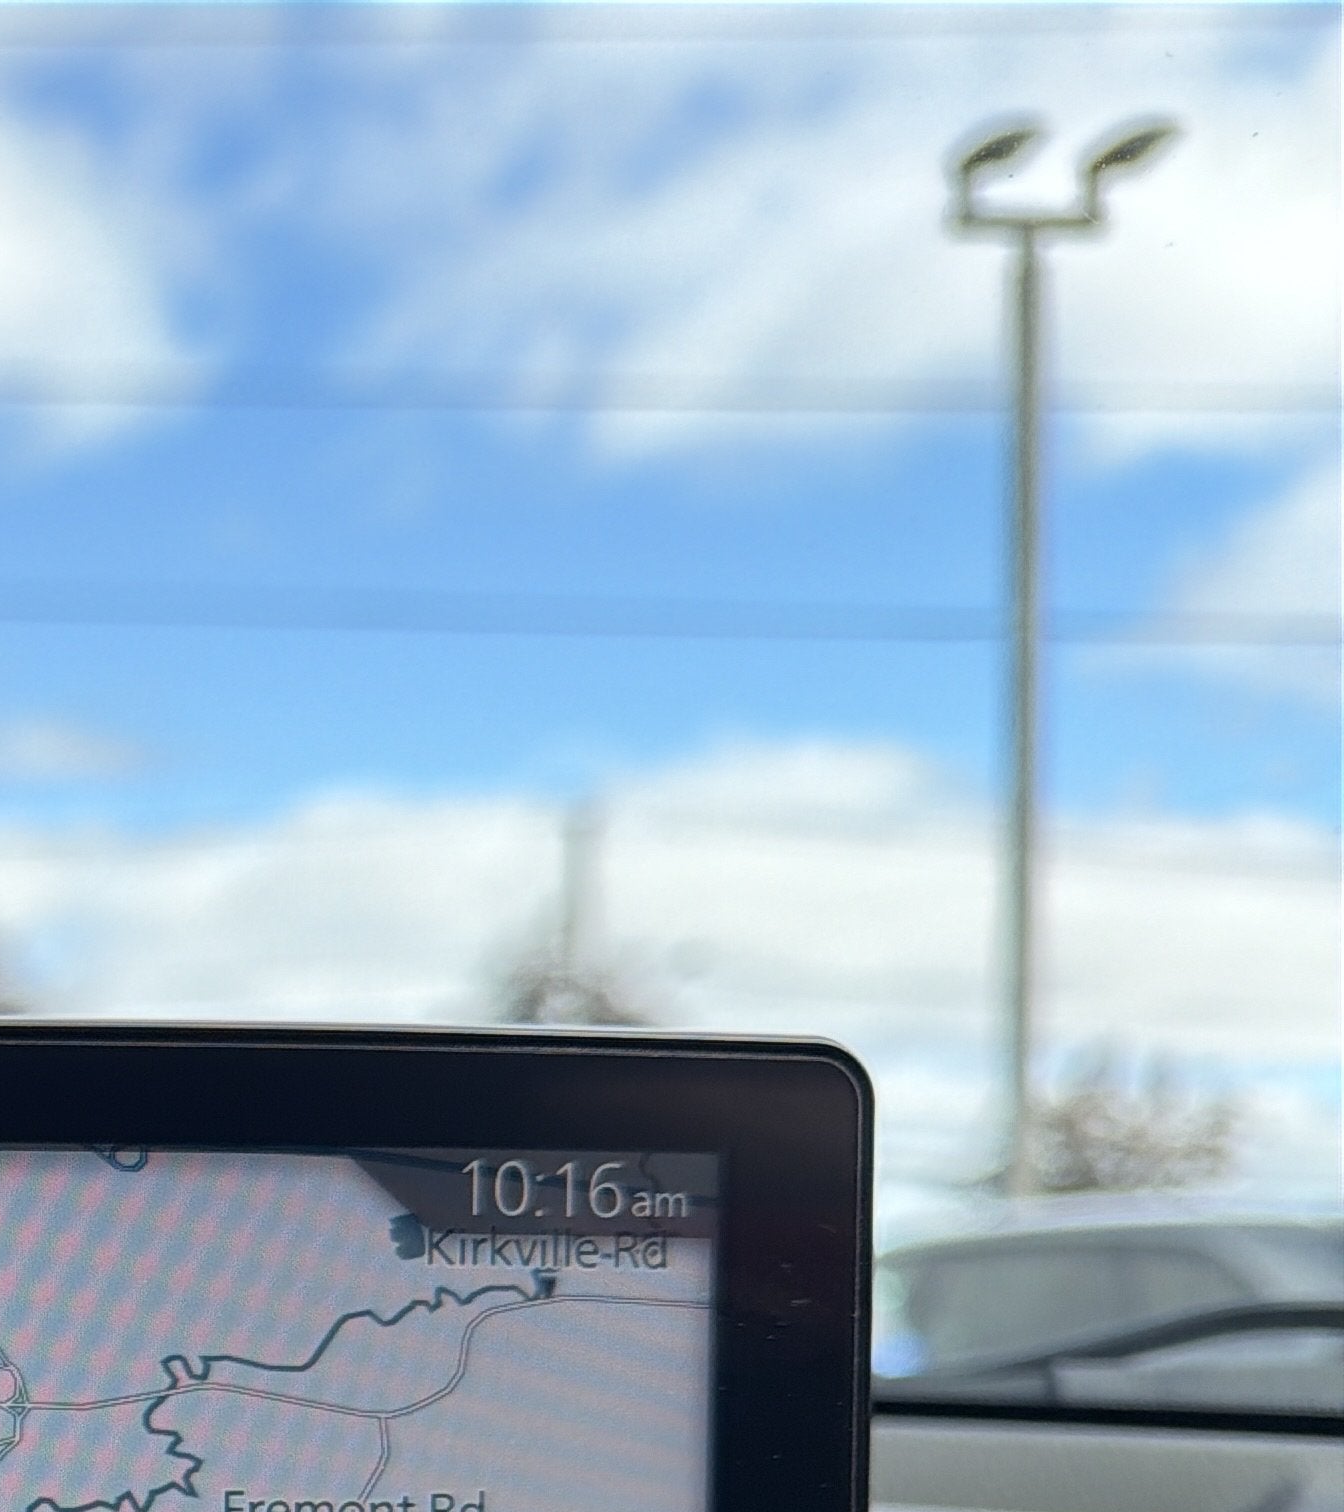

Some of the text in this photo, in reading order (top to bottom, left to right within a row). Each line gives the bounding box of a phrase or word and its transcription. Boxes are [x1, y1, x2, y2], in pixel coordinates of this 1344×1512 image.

[462, 1158, 688, 1218] 10:16 am
[426, 1226, 667, 1269] Kirkville Rd
